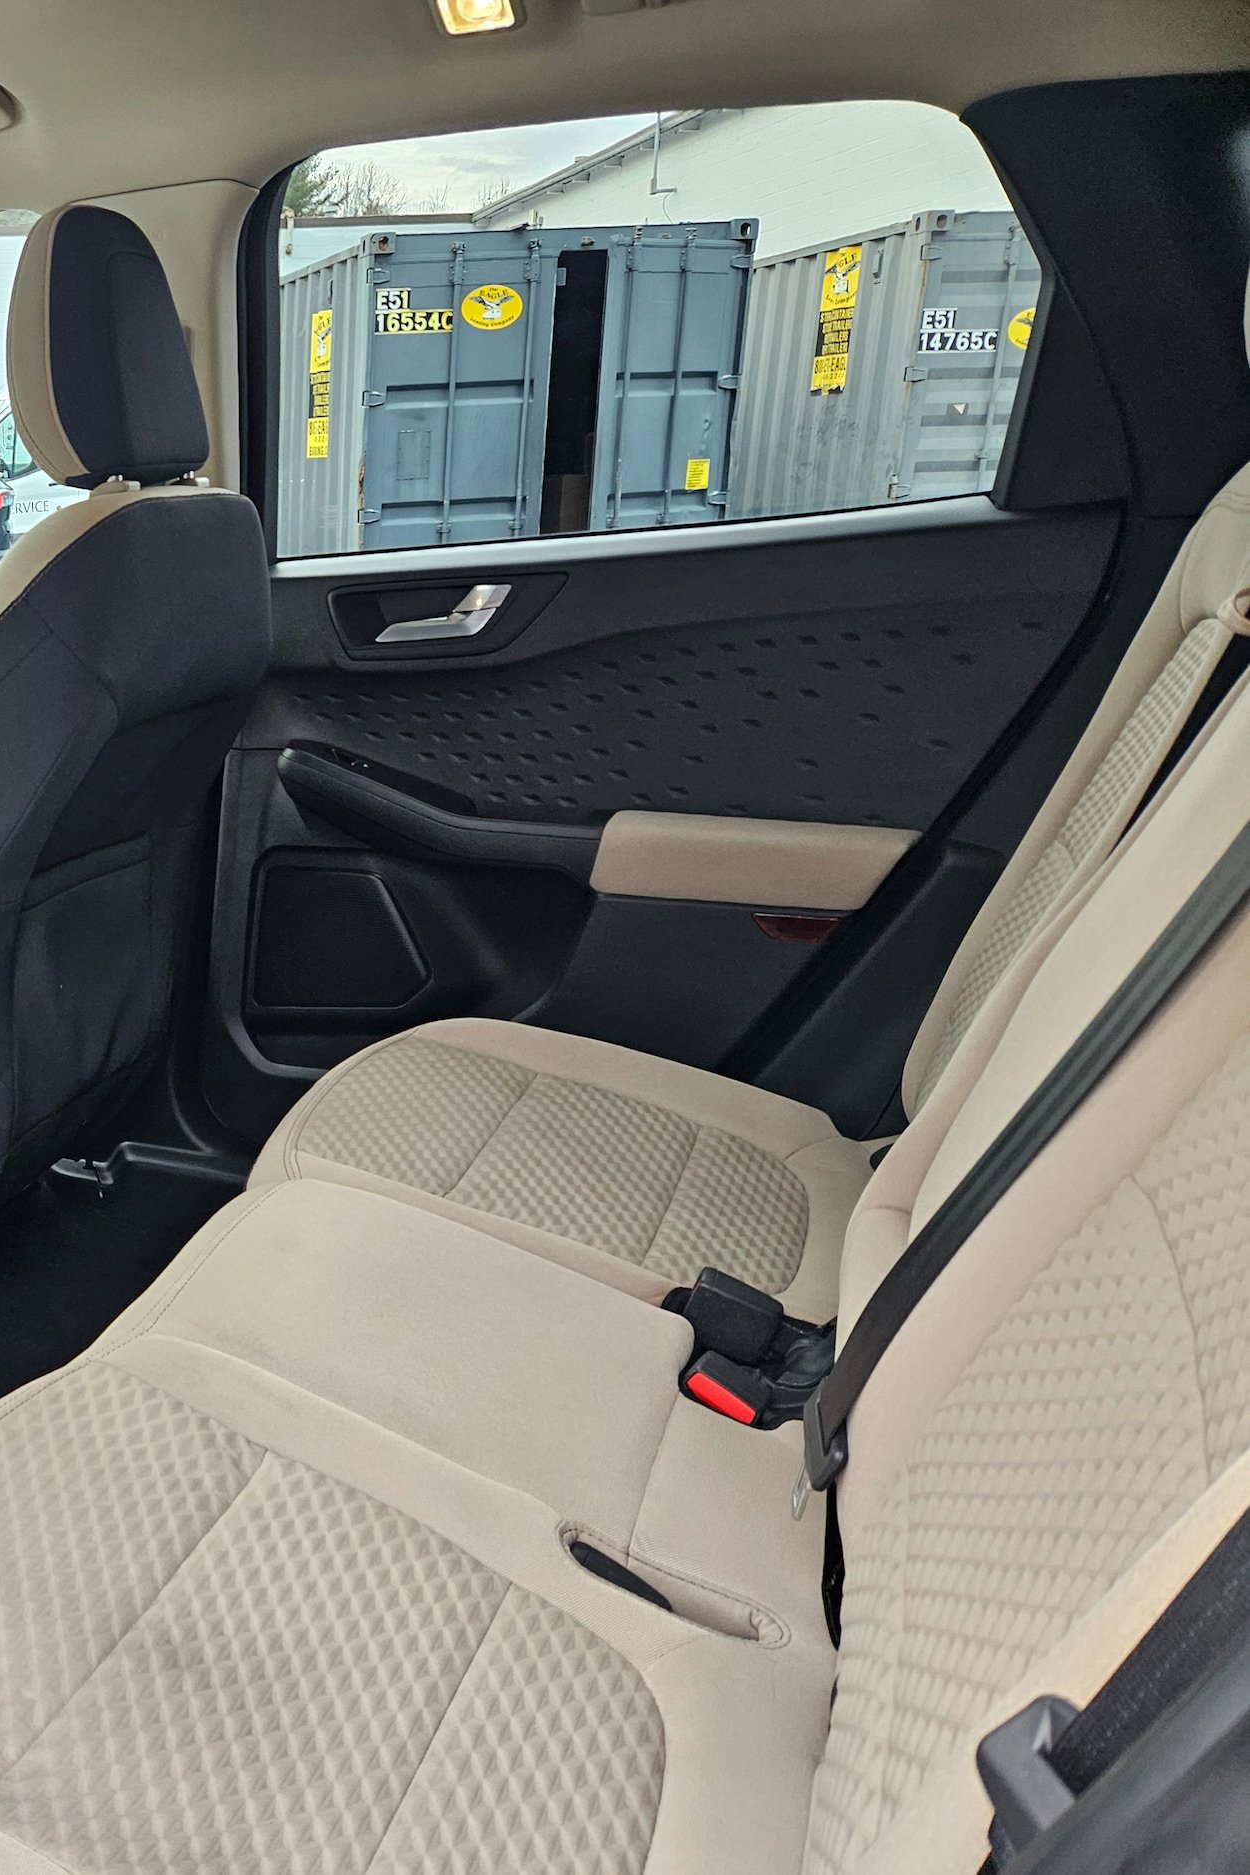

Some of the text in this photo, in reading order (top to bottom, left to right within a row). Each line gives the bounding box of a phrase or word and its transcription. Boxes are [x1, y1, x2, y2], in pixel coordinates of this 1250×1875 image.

[376, 290, 410, 310] E51
[480, 289, 509, 300] EAGLE
[376, 311, 454, 333] 16554C
[470, 315, 515, 328] Leasing Company
[921, 310, 956, 329] E51
[920, 331, 998, 352] 14765C
